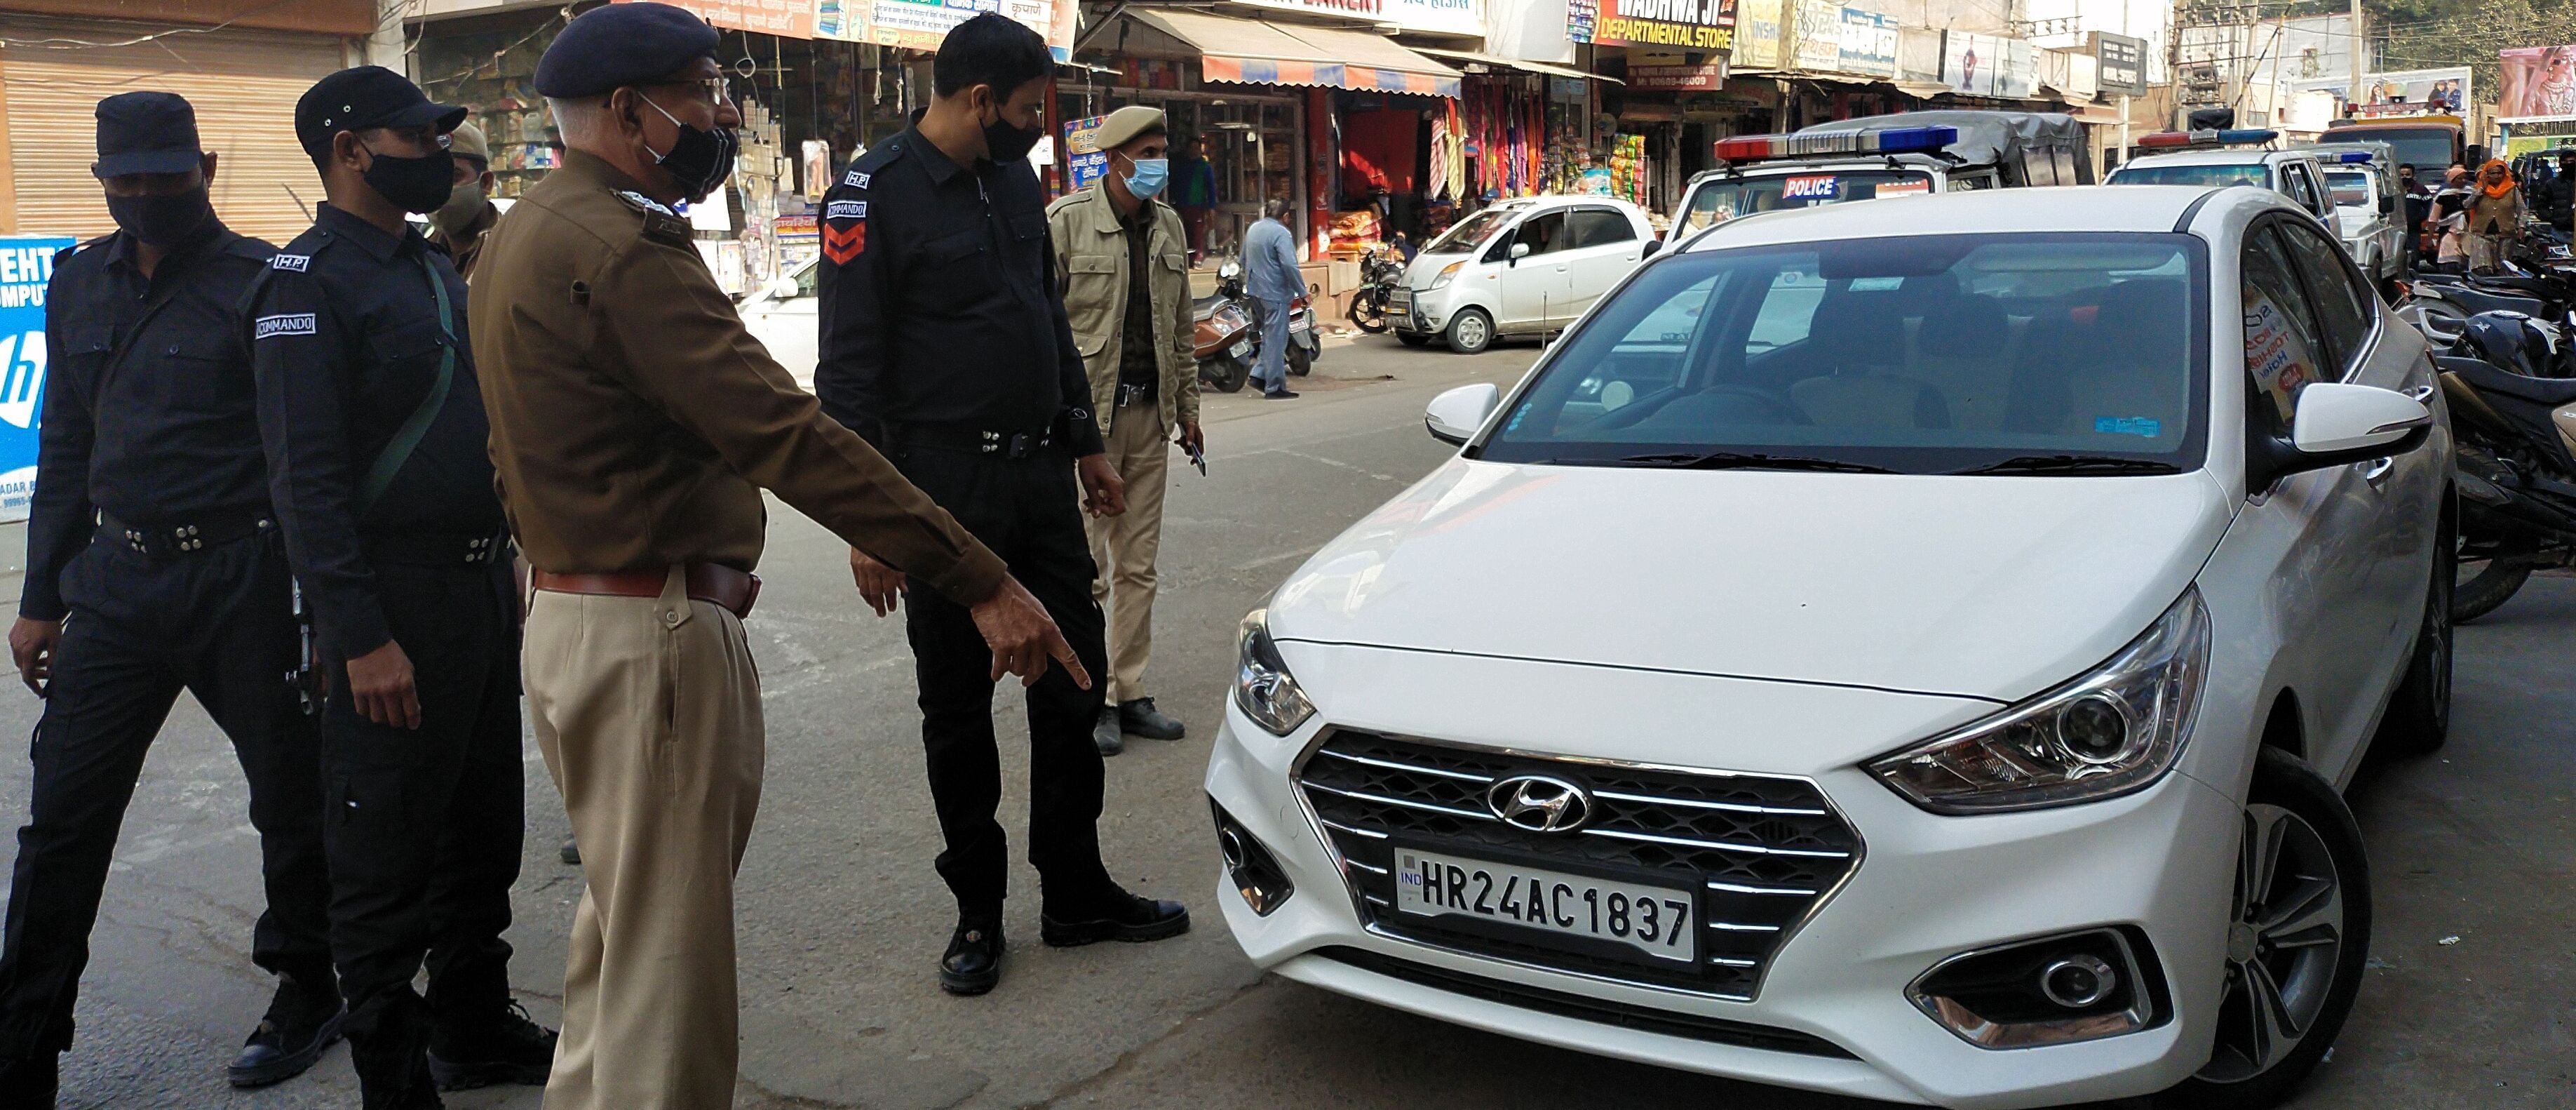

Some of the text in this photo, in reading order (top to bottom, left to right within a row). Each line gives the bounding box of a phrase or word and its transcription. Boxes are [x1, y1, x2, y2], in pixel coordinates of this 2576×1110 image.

[1600, 17, 1733, 50] DEPARTMENTAL STORE
[1753, 21, 1780, 40] INSH
[1786, 178, 1834, 196] POLICE
[0, 247, 65, 283] EHT
[0, 283, 48, 307] MPU
[257, 316, 312, 335] COMMANDO
[1401, 860, 1689, 947] IND HR24AC1837
